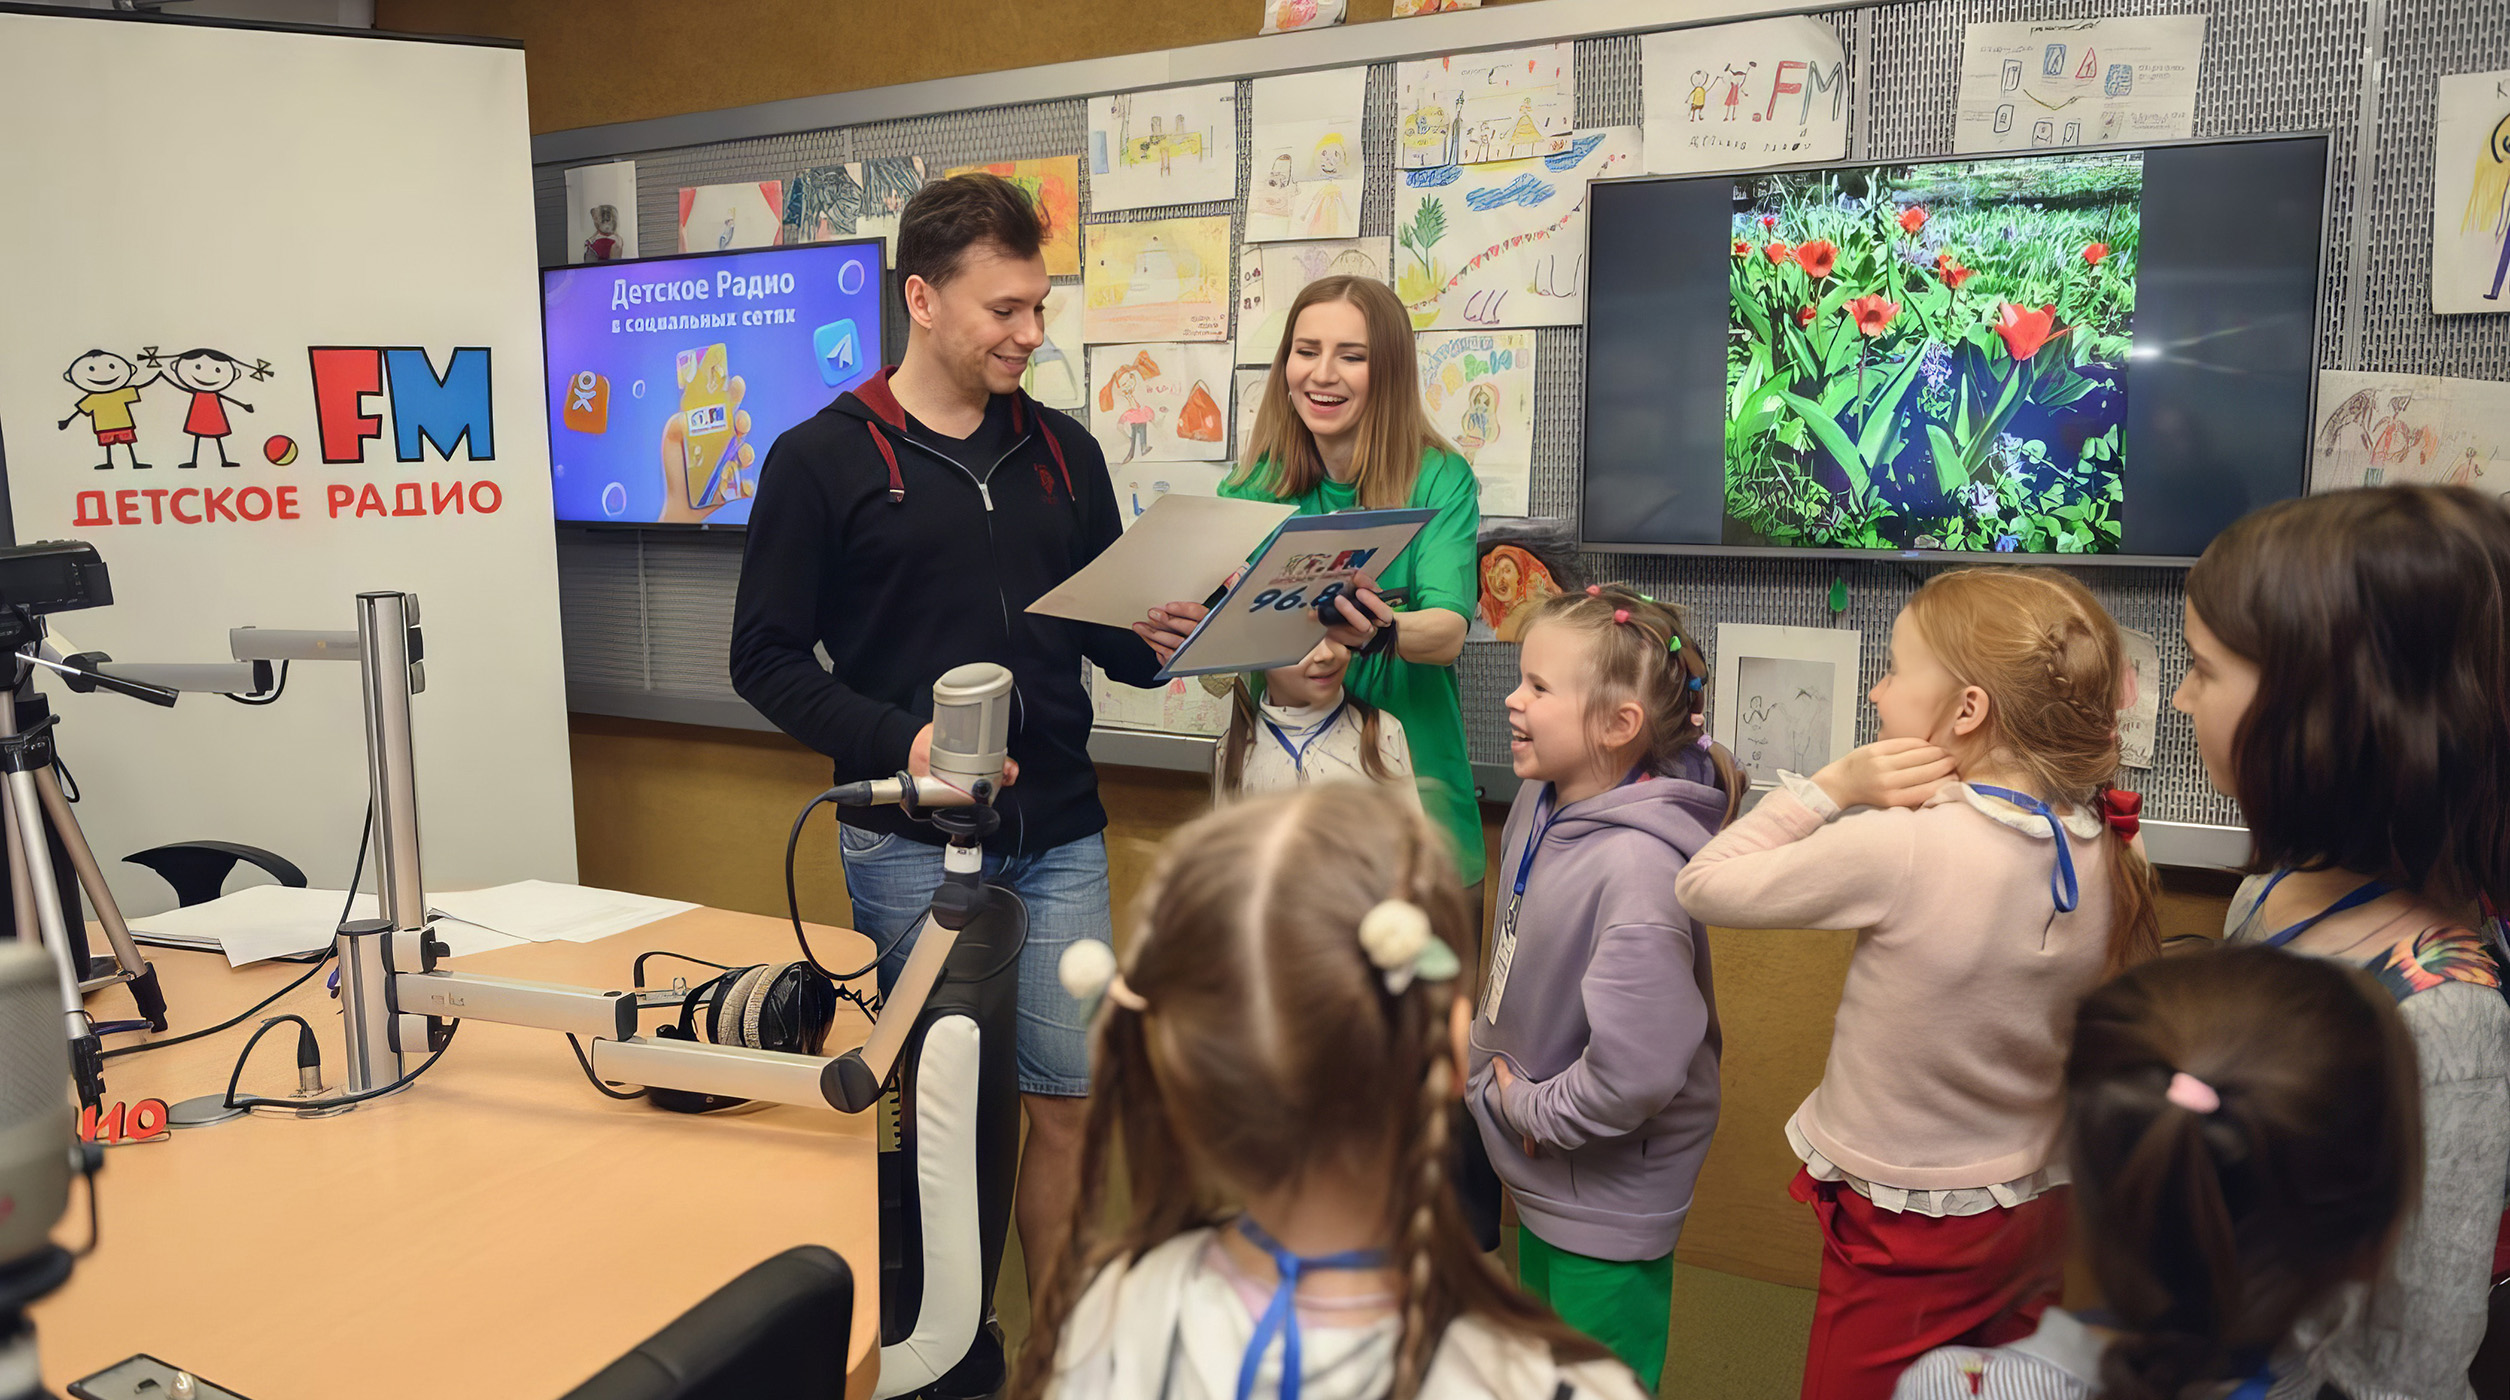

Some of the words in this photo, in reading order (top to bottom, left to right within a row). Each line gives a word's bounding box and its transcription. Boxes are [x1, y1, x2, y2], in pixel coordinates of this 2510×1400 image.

[611, 278, 710, 311] Детское
[716, 270, 796, 300] Радио
[611, 319, 621, 333] в
[625, 312, 737, 332] социальных
[742, 308, 796, 326] сетях
[307, 345, 496, 465] FM
[72, 485, 301, 527] ДЕТСКОЕ
[326, 480, 503, 519] РАДИО
